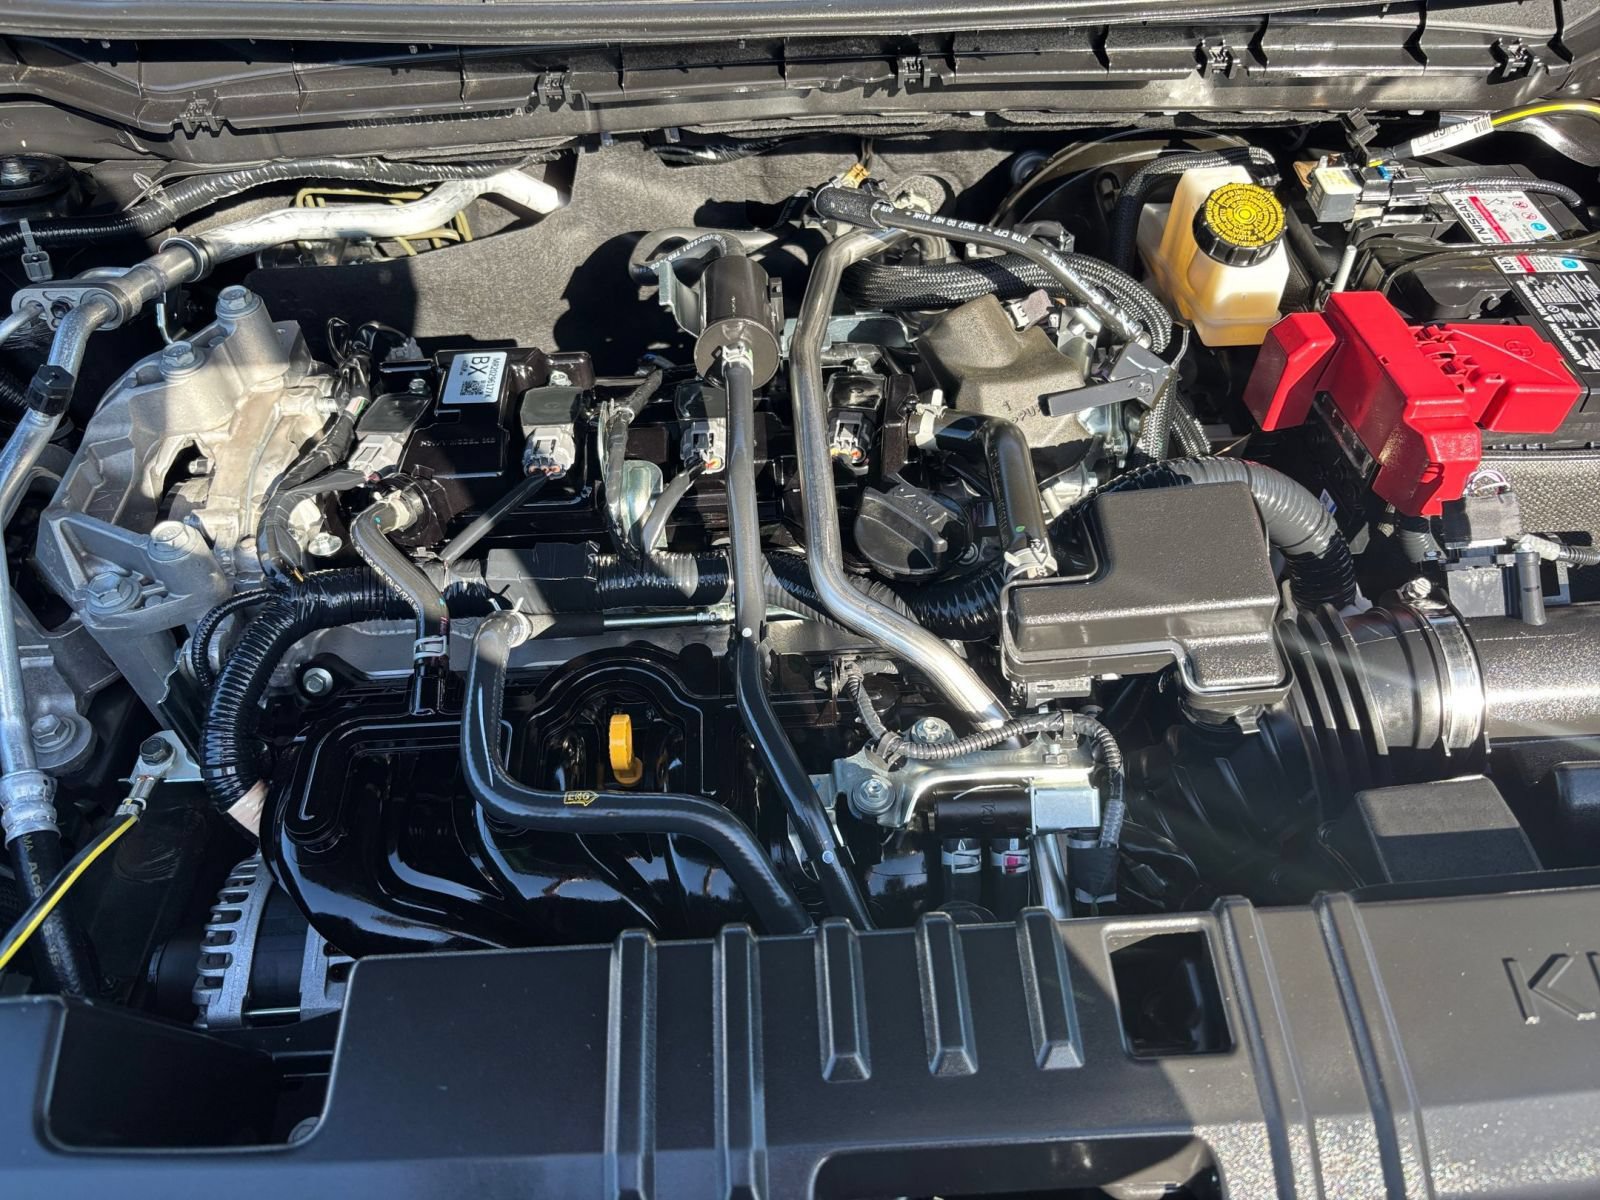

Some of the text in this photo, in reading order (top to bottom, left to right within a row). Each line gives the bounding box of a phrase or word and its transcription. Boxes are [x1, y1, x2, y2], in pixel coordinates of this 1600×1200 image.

[1452, 198, 1488, 235] NISSAN
[467, 356, 491, 376] BX
[567, 793, 590, 801] ENG
